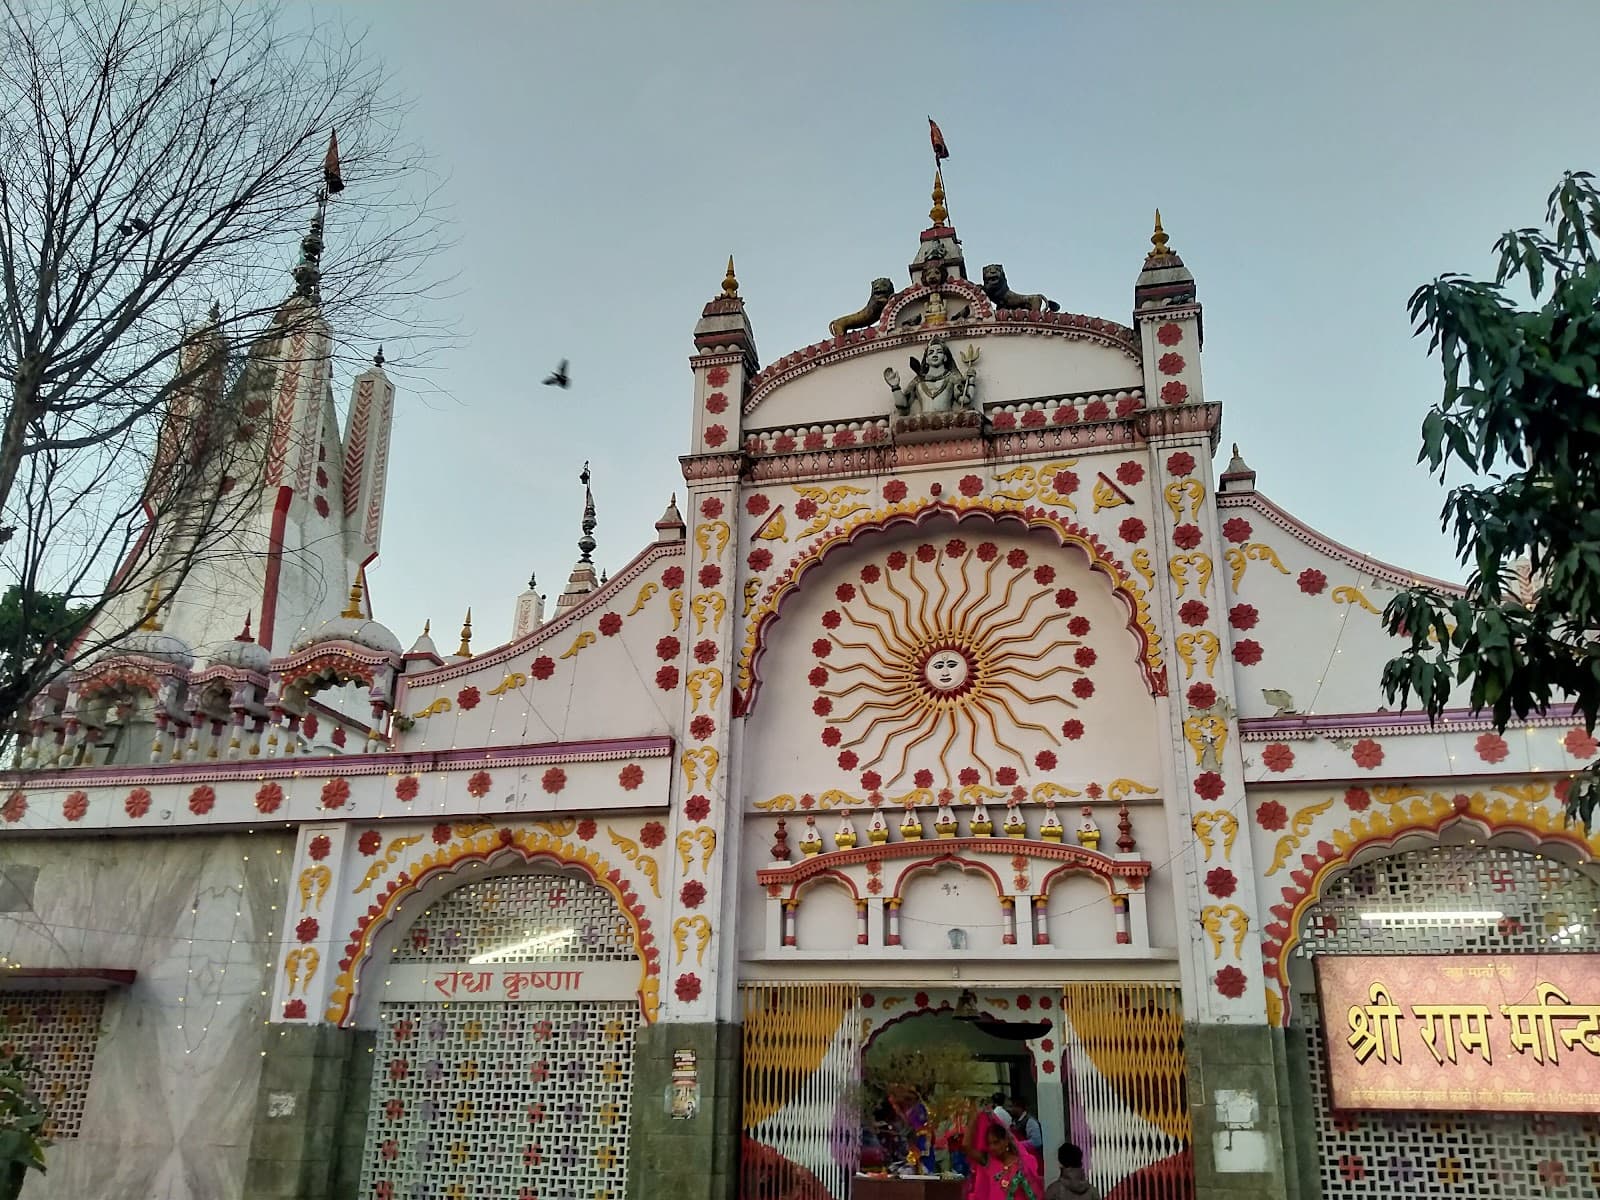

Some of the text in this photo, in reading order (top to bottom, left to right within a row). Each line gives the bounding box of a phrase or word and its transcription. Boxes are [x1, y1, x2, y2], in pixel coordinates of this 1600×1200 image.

[434, 971, 584, 999] राधा कृष्णा
[1347, 982, 1404, 1065] श्री
[1411, 1004, 1492, 1066] राम
